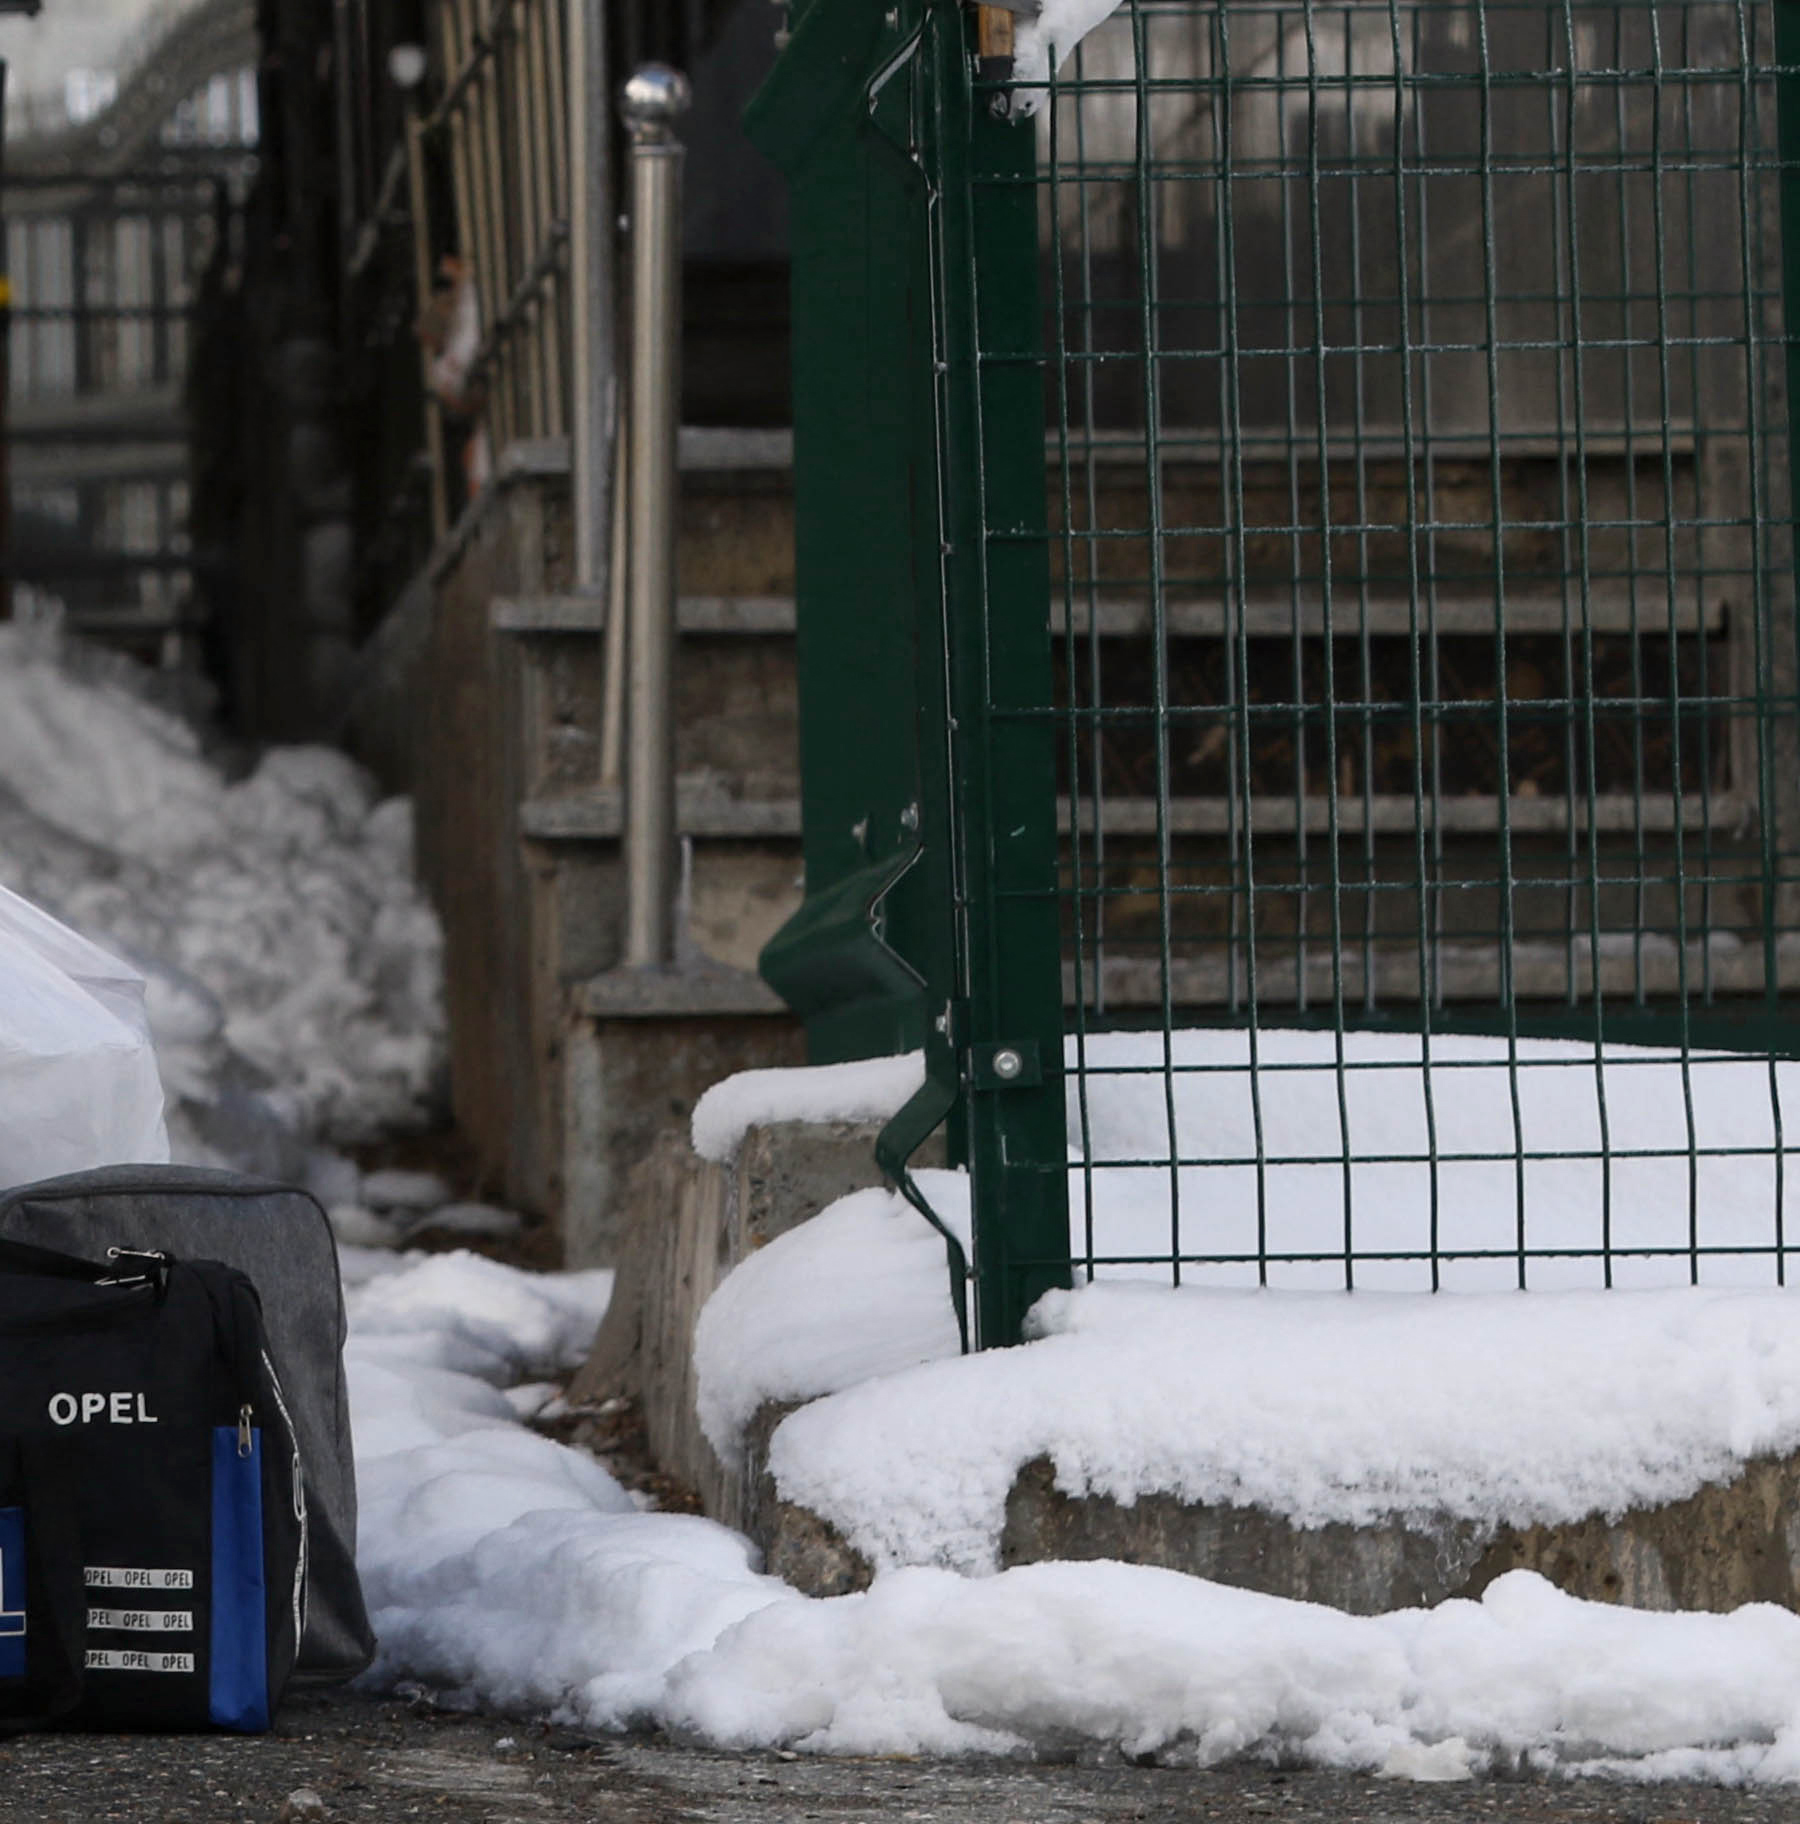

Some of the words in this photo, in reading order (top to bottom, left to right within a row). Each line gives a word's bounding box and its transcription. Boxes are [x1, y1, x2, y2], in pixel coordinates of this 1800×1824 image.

[48, 1392, 158, 1426] OPEL
[85, 1569, 113, 1585] OPEL
[124, 1570, 152, 1586] OPEL
[164, 1571, 190, 1587] OPEL
[123, 1612, 151, 1628] OPEL
[163, 1614, 190, 1629] OPEL
[122, 1653, 150, 1668] OPEL
[162, 1655, 189, 1670] OPEL
